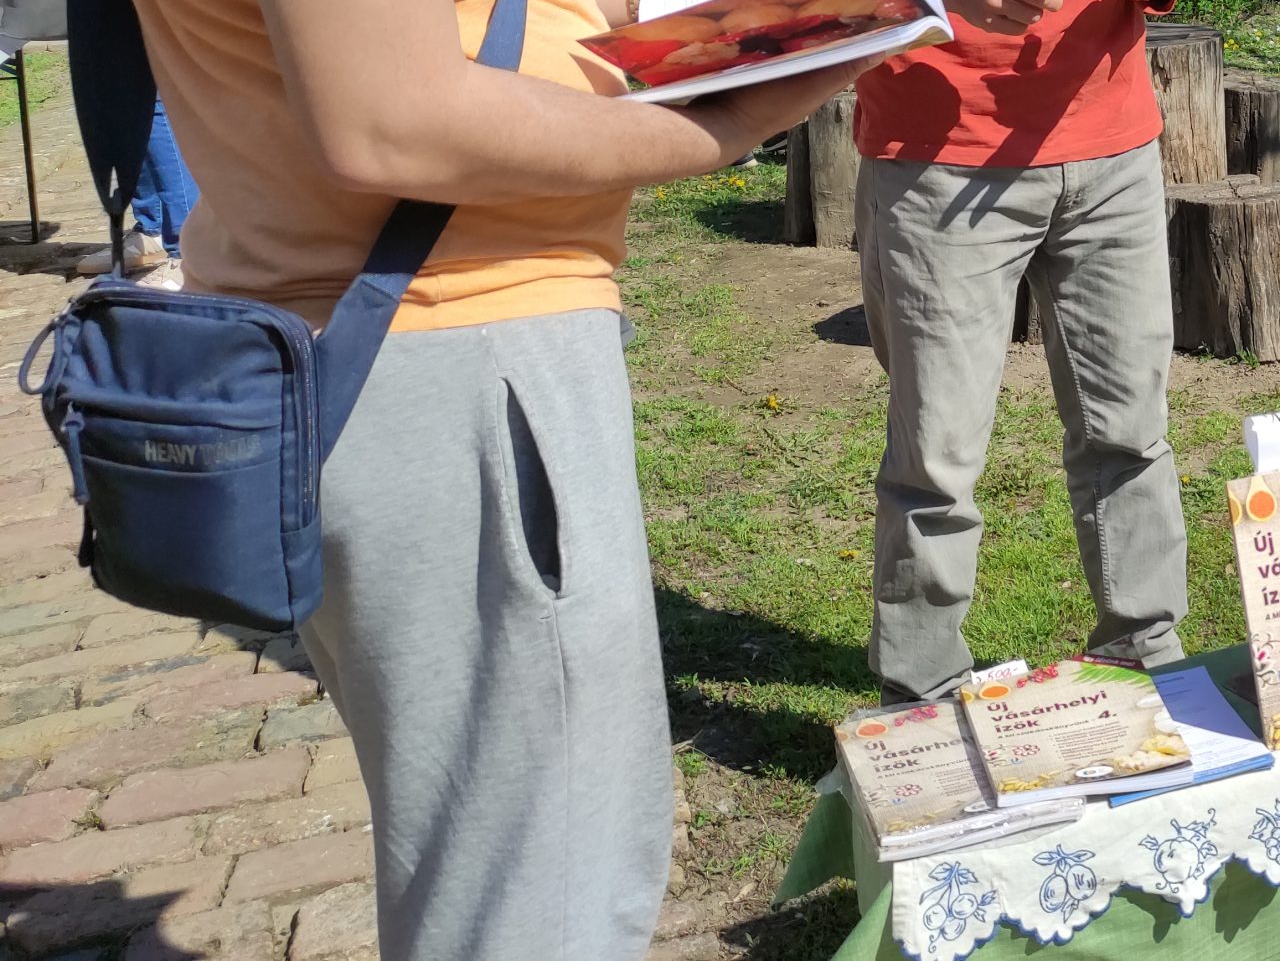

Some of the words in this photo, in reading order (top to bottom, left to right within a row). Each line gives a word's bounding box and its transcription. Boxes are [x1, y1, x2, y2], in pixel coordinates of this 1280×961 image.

[144, 440, 197, 465] HEAVY
[1253, 530, 1274, 556] Új
[987, 701, 1009, 714] Új
[991, 690, 1108, 722] vásárhelyi
[1098, 710, 1118, 720] 4.
[994, 720, 1040, 734] ízök
[864, 741, 887, 752] Új
[873, 758, 920, 773] ízök
